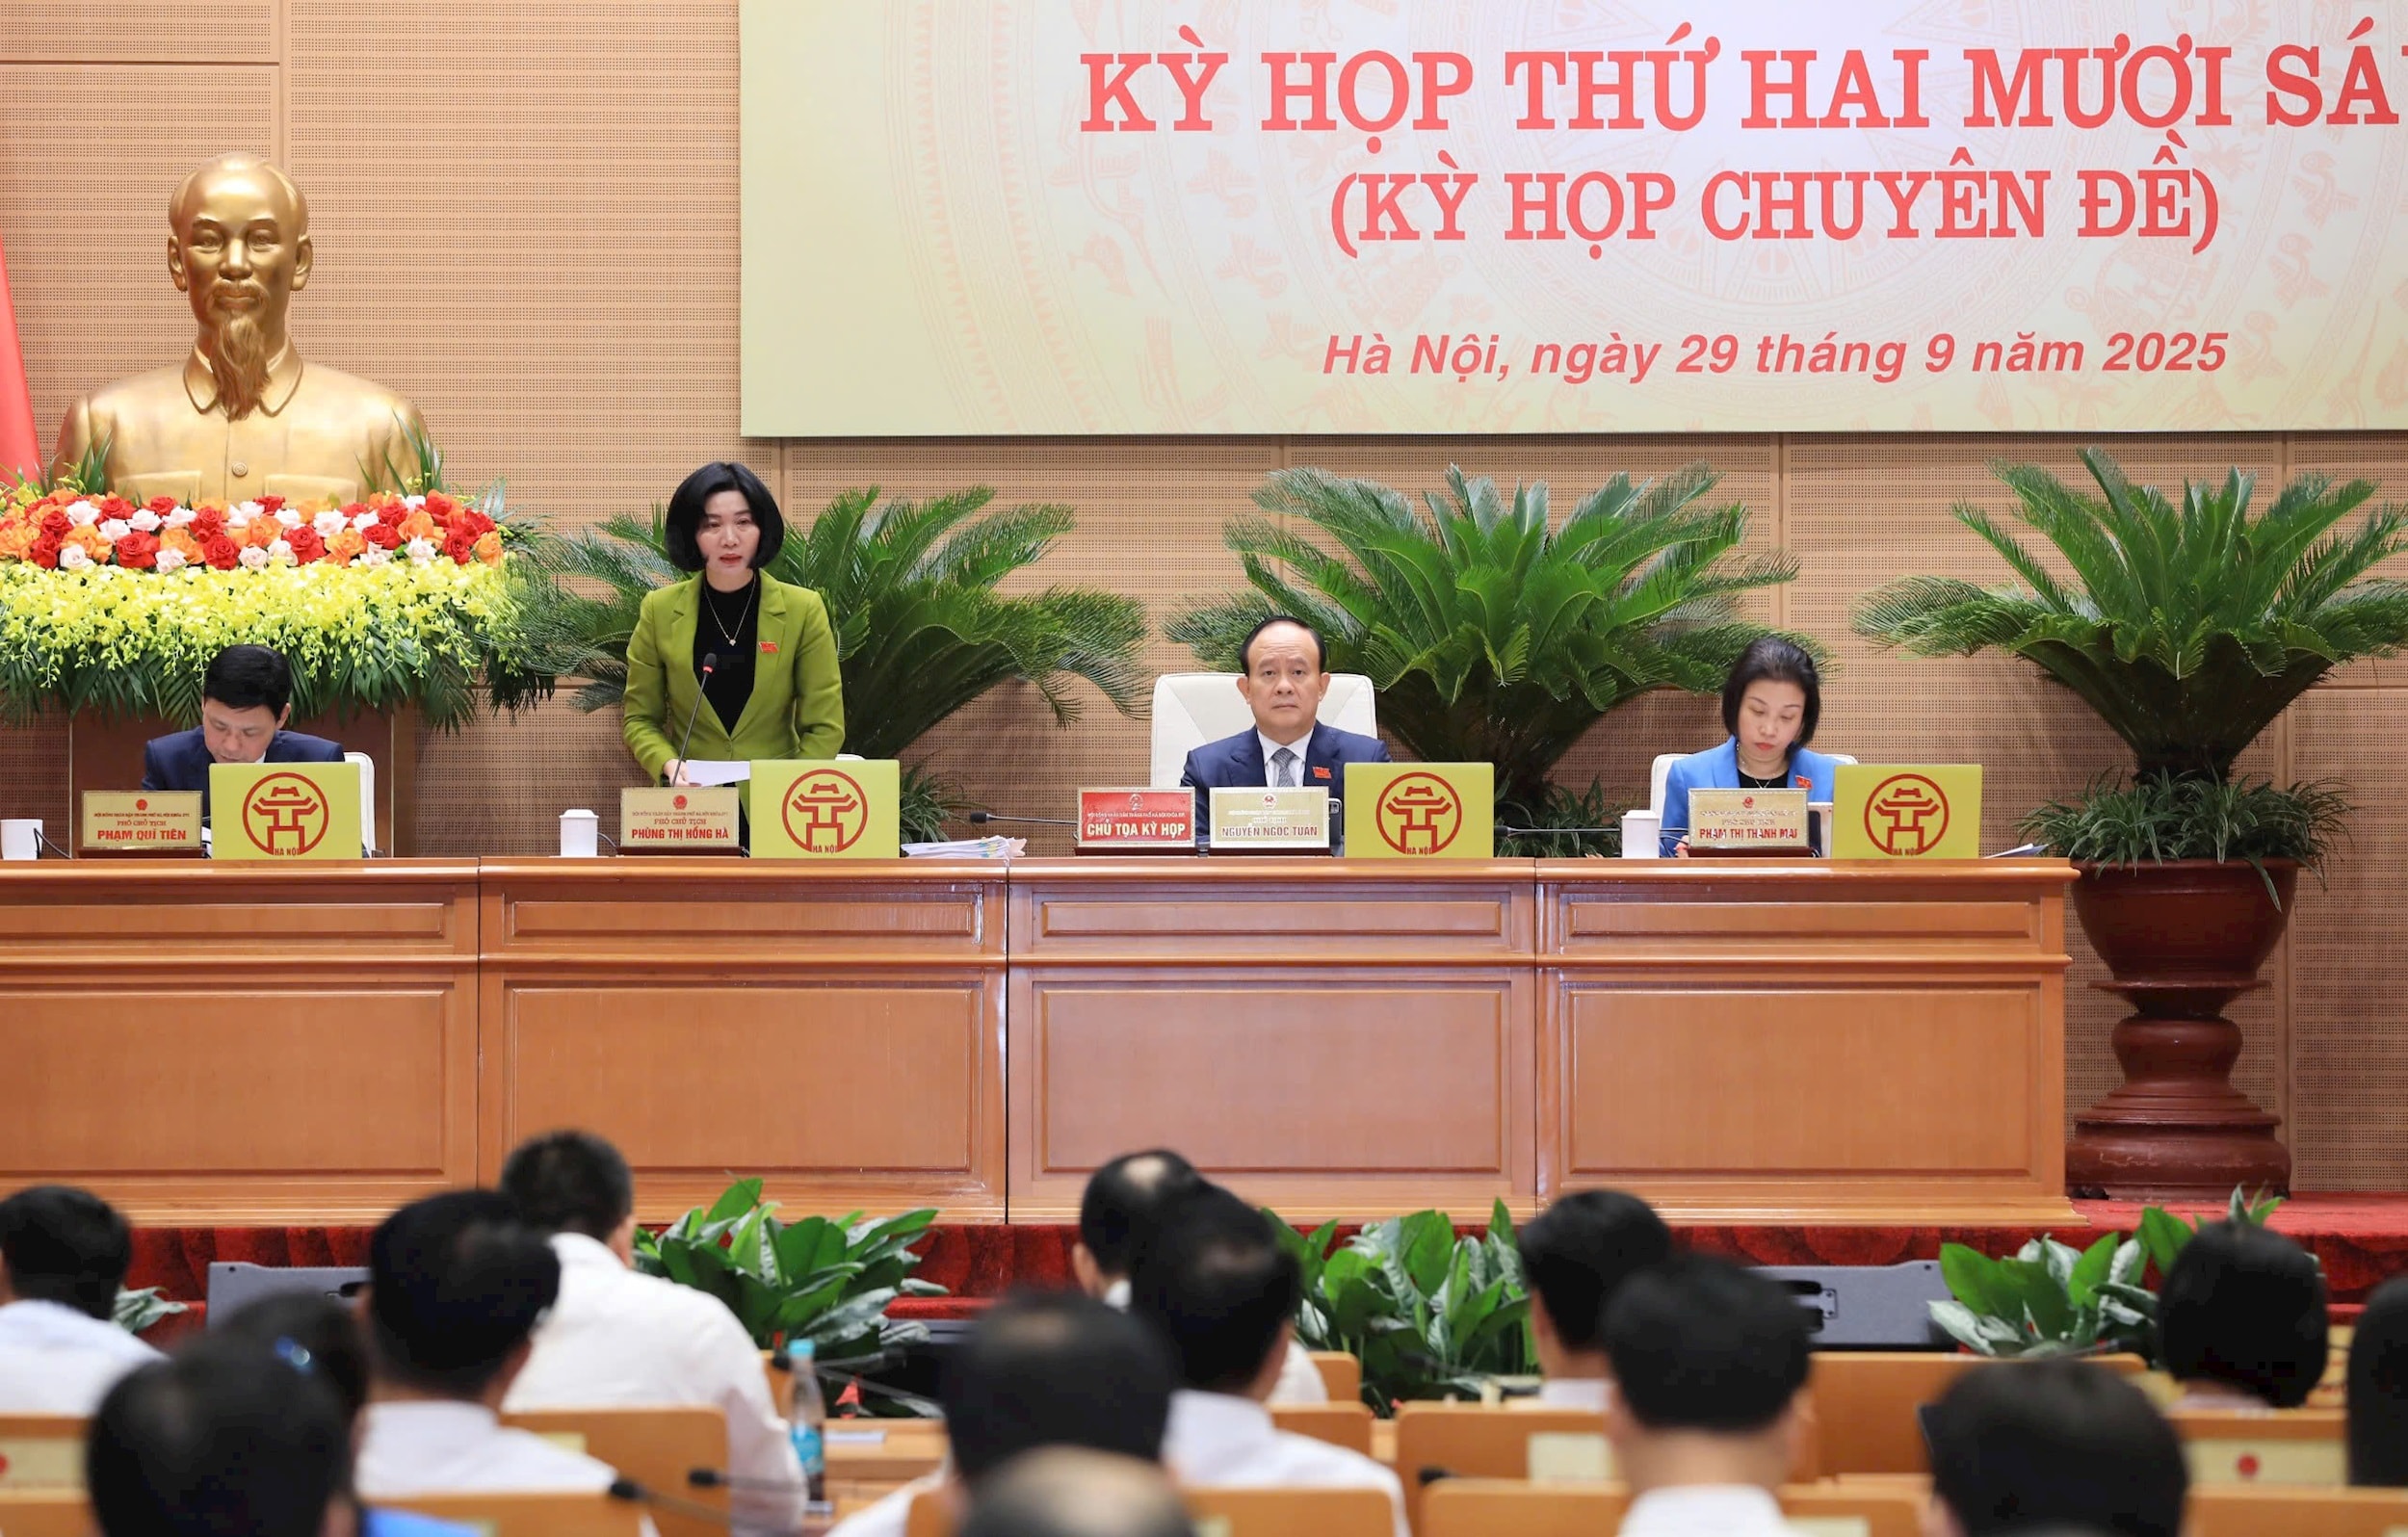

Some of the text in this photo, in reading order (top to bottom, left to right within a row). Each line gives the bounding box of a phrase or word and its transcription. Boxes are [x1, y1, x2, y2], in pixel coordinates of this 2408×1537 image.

[1080, 16, 2408, 154] KỲ HỌP THỨ HAI MƯƠI SÁ
[1331, 128, 2219, 260] (KỲ HỌP CHUYÊN ĐỀ)
[1322, 331, 2229, 384] Hà Nội, ngày 29 tháng 9 năm 2025
[97, 829, 133, 842] PHẠM
[667, 828, 683, 841] THỊ
[716, 826, 729, 839] HÀ
[1086, 818, 1186, 839] CHỦ TỌA KỲ HỌP
